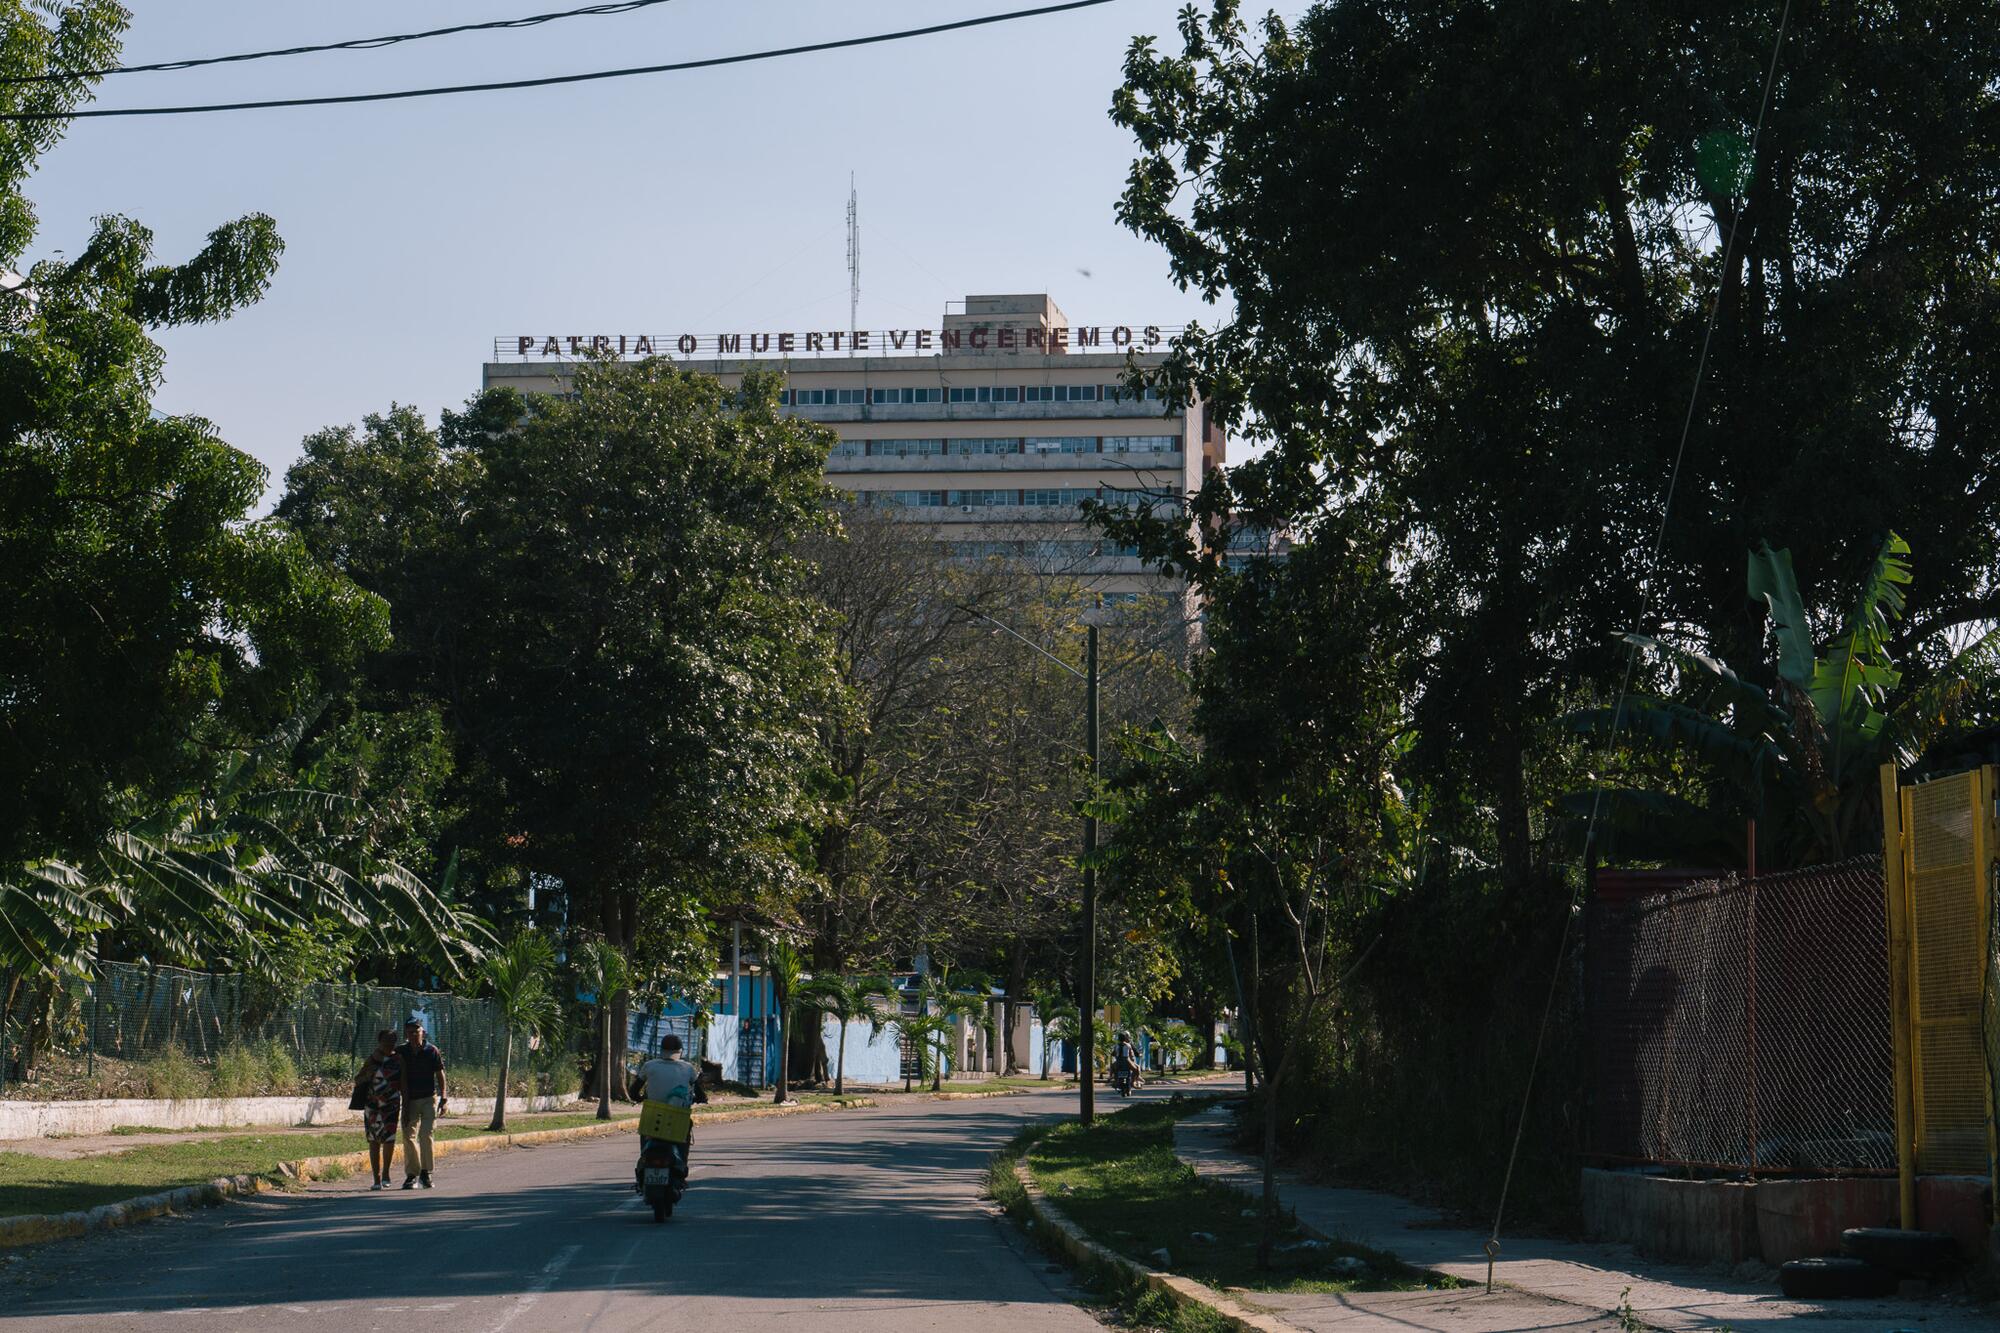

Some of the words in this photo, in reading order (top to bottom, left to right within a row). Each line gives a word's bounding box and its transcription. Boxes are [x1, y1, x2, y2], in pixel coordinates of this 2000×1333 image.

[518, 335, 655, 356] PATRIA
[677, 334, 698, 354] O
[719, 331, 869, 353] MUERTE
[889, 325, 1161, 350] VENCEREMOS
